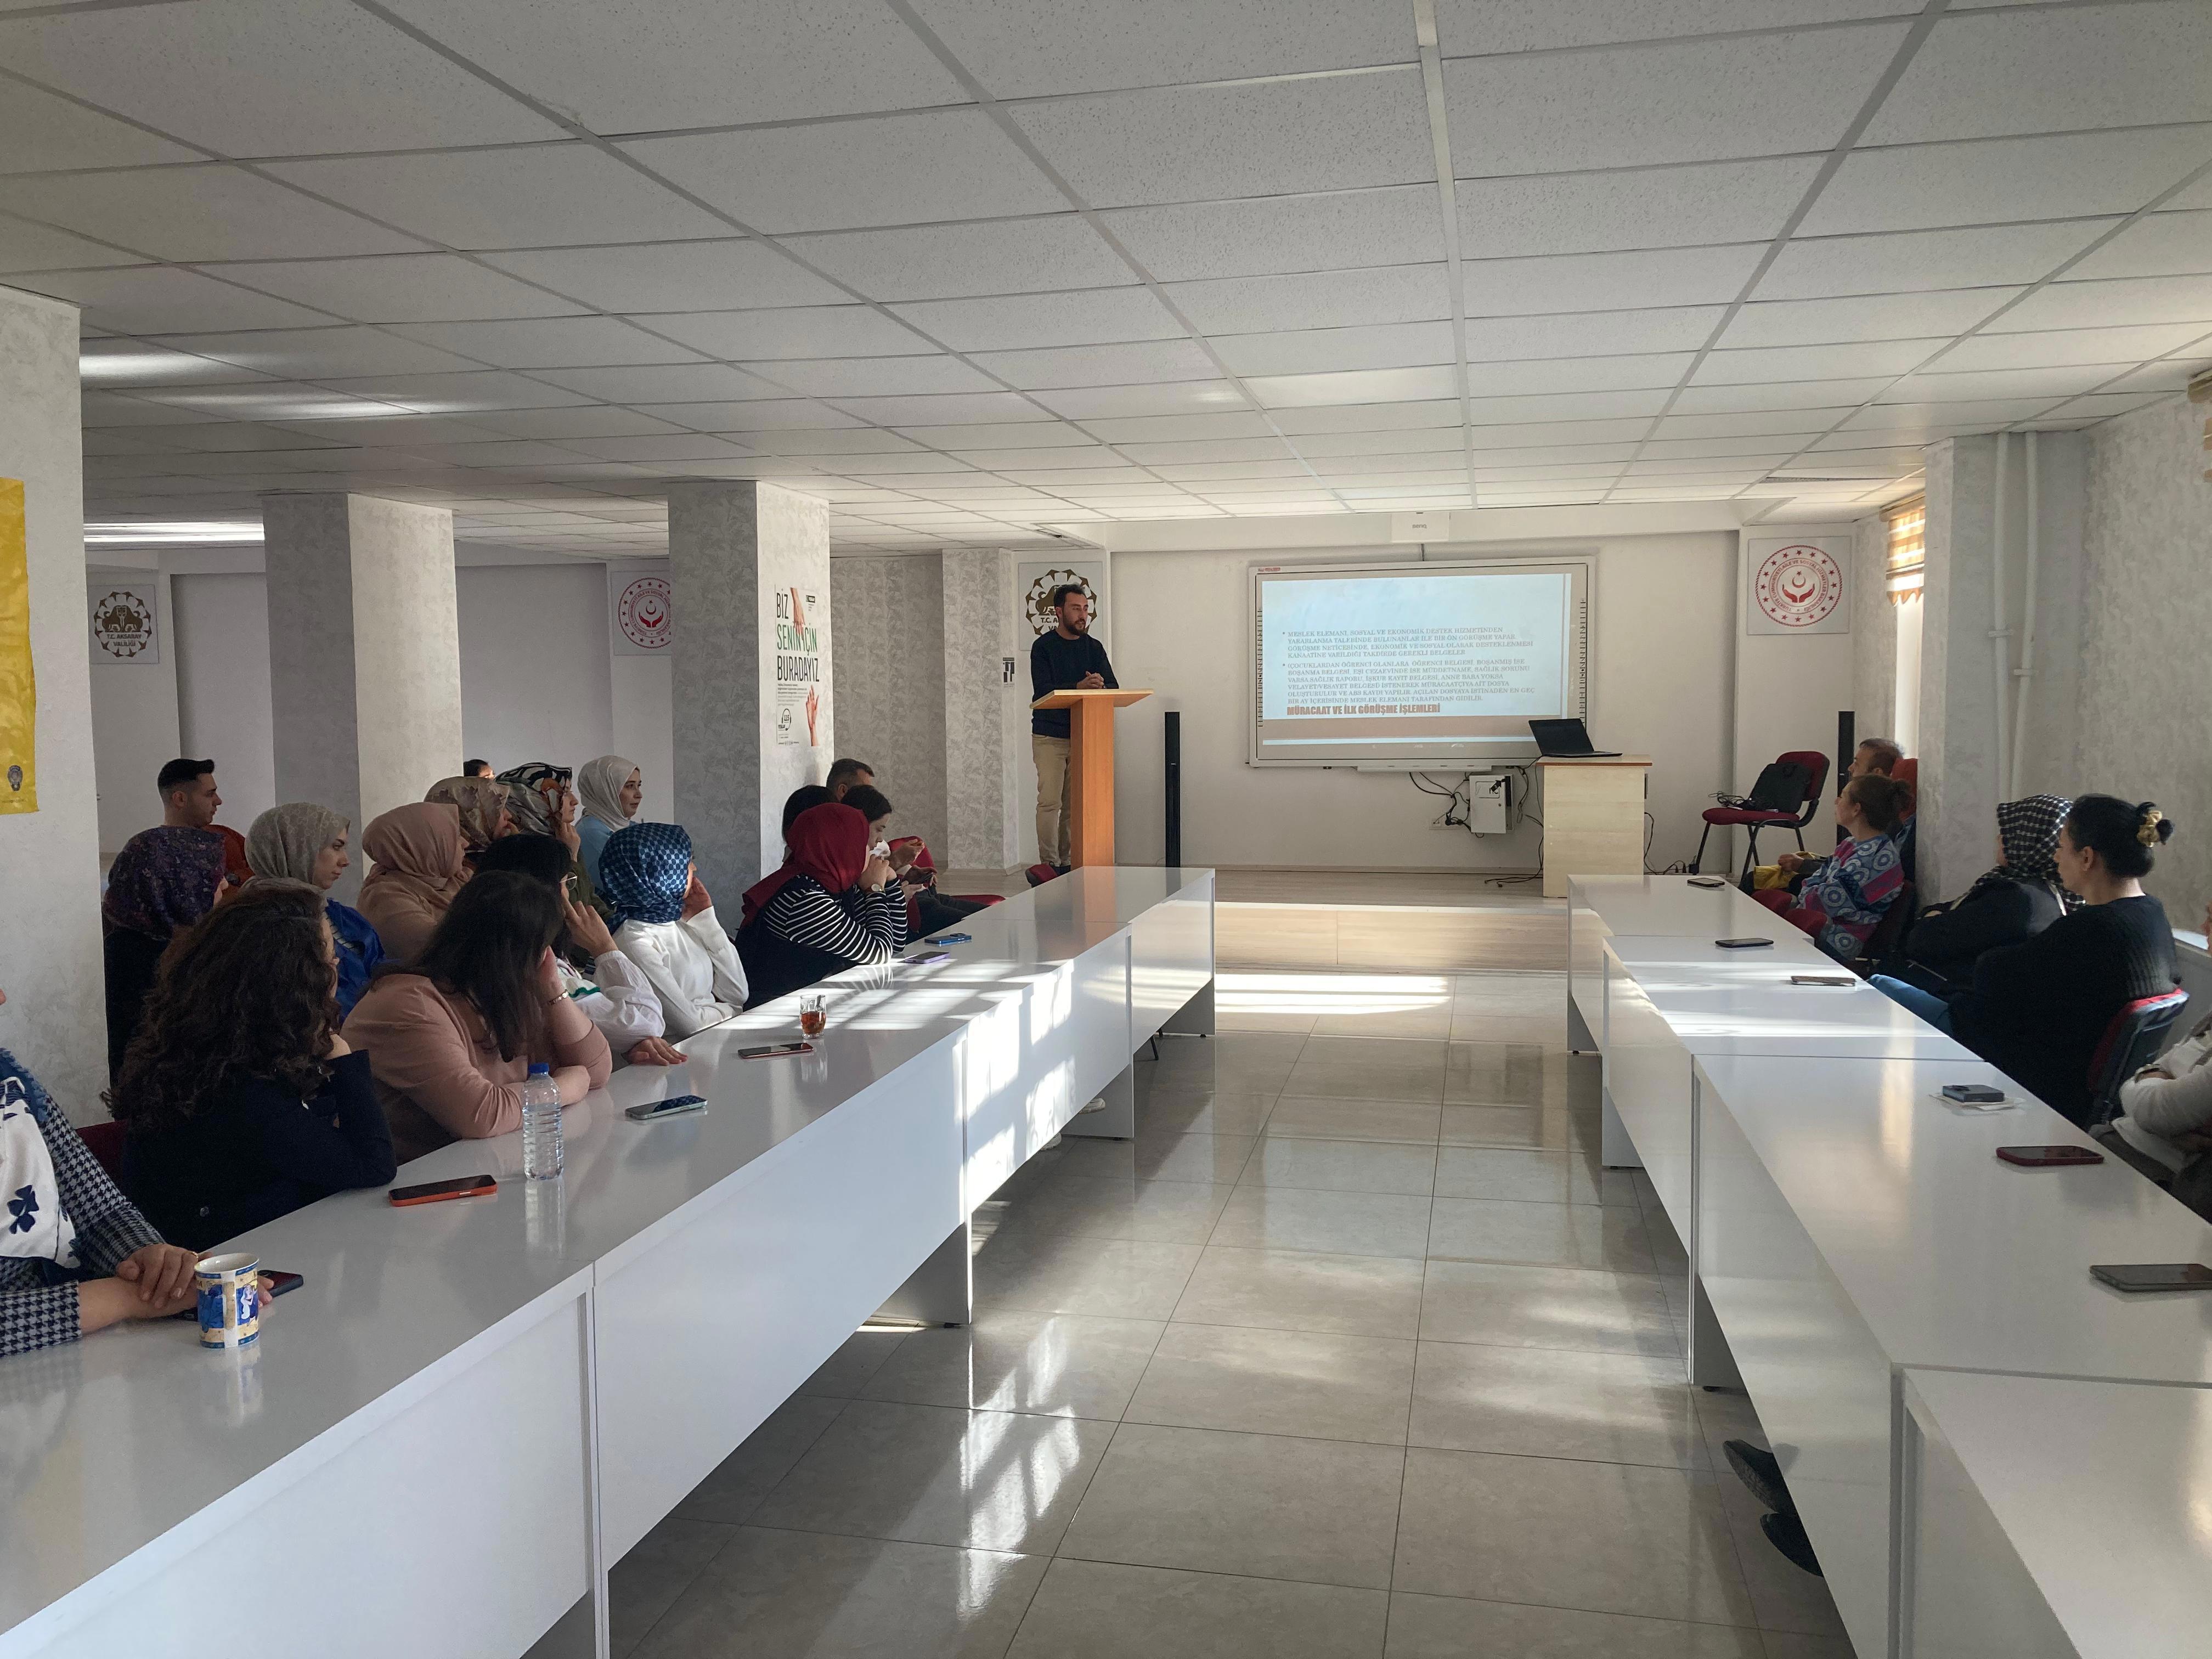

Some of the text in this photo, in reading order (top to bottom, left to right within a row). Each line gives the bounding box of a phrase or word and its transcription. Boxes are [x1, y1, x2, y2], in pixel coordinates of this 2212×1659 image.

[776, 588, 789, 619] BİZ
[777, 624, 802, 652] SENİN
[777, 655, 820, 682] BURADAYIZ
[1286, 703, 1440, 715] MÜRACAAT VE İLK GÖRÜŞME İŞLEMLERİ
